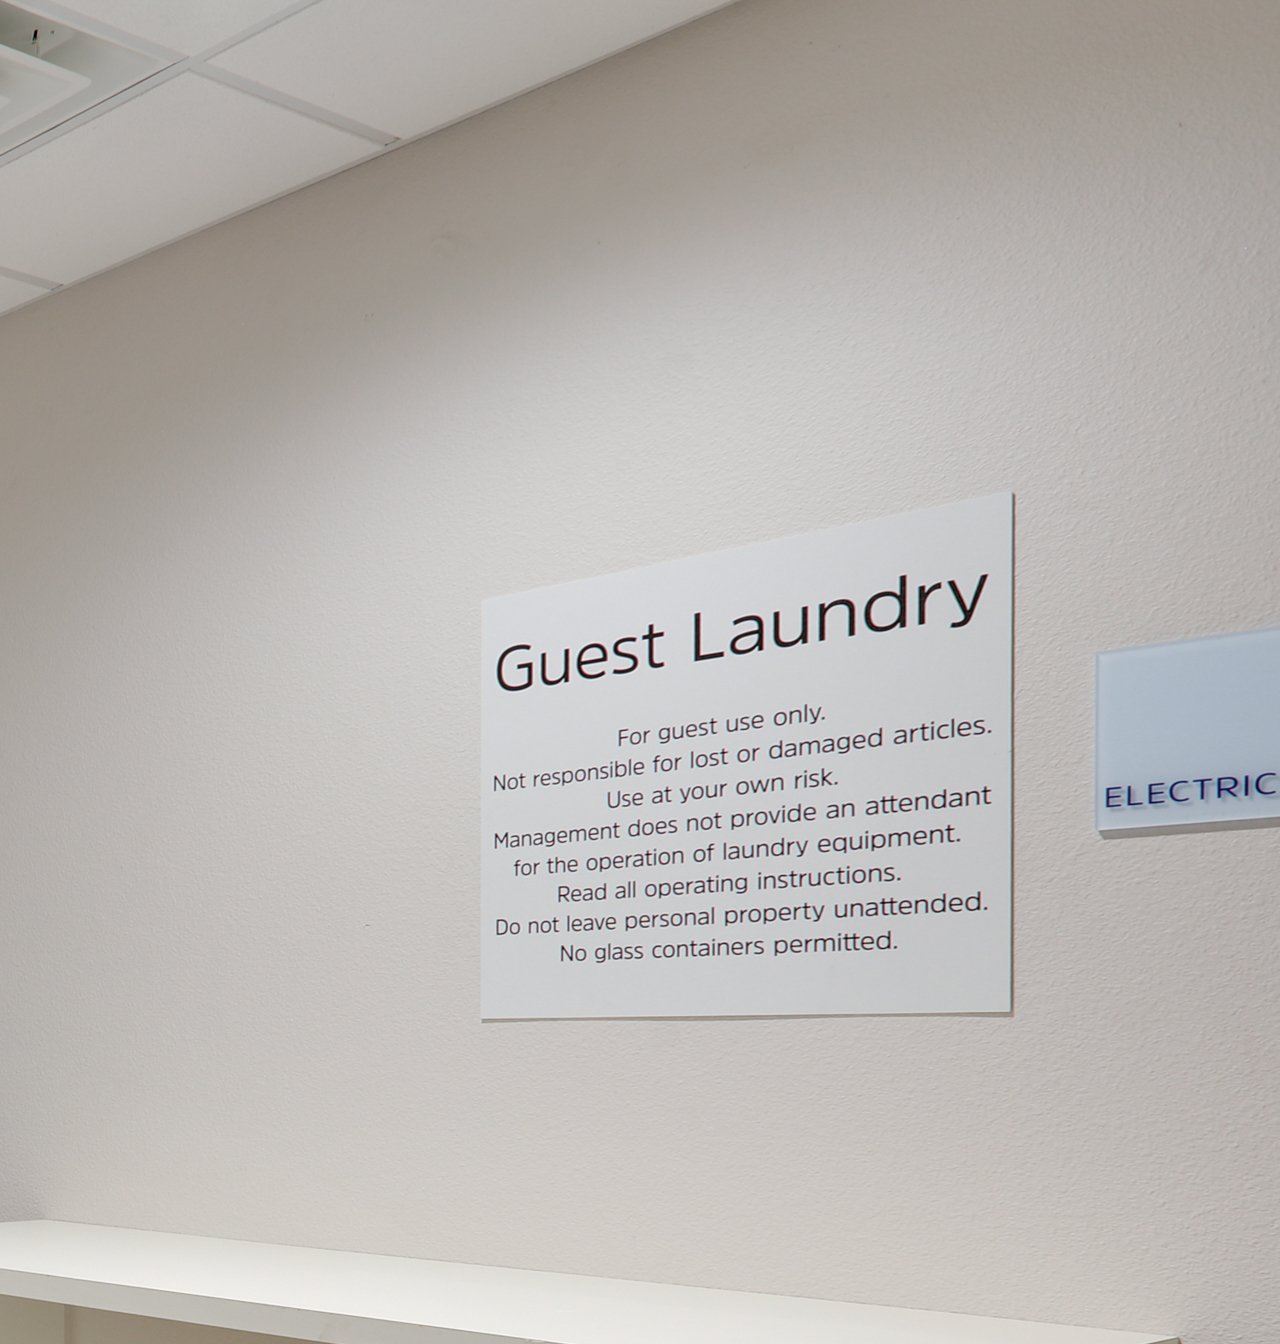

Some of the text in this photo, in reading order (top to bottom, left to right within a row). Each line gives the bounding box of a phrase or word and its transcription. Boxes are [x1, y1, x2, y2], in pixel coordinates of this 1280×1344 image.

[496, 574, 989, 692] Guest Laundry
[618, 704, 825, 747] For guest use only.
[494, 718, 992, 792] Not responsible for lost or damaged articles.
[607, 768, 838, 809] Use at your own risk.
[1105, 772, 1277, 808] ELECTRIC
[494, 786, 992, 849] Management does not provide an attendant
[513, 824, 961, 876] for the operation of laundry equipment.
[558, 865, 901, 903] Read all operating instructions.
[496, 891, 988, 936] Do not leave personal property unattended.
[561, 930, 898, 963] No glass containers permitted.
